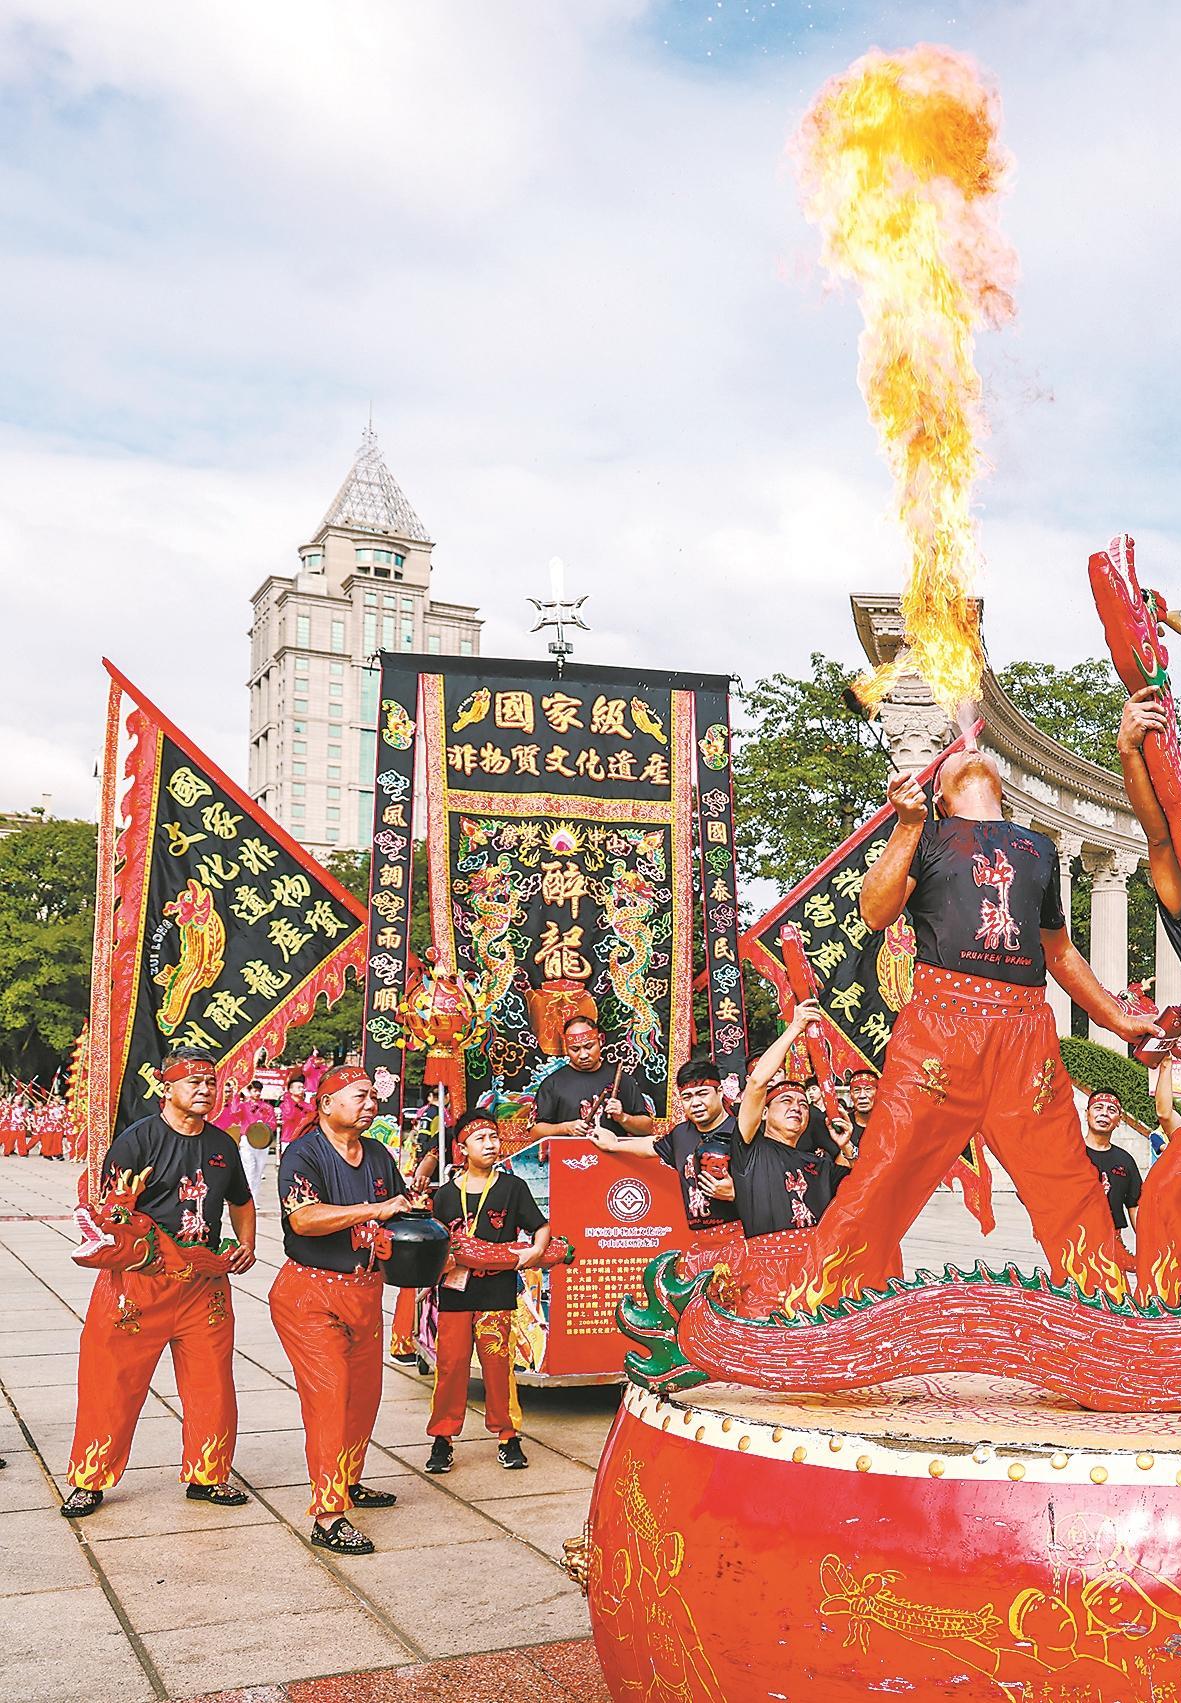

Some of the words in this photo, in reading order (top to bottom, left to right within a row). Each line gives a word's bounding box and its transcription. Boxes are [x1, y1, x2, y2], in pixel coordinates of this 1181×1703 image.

[151, 919, 173, 950] LONG
[373, 804, 408, 1011] 風調雨順
[534, 860, 593, 980] 醉龍
[706, 821, 740, 1022] 國泰民安
[150, 954, 159, 975] ZUI
[960, 951, 1002, 963] DRUNKEN
